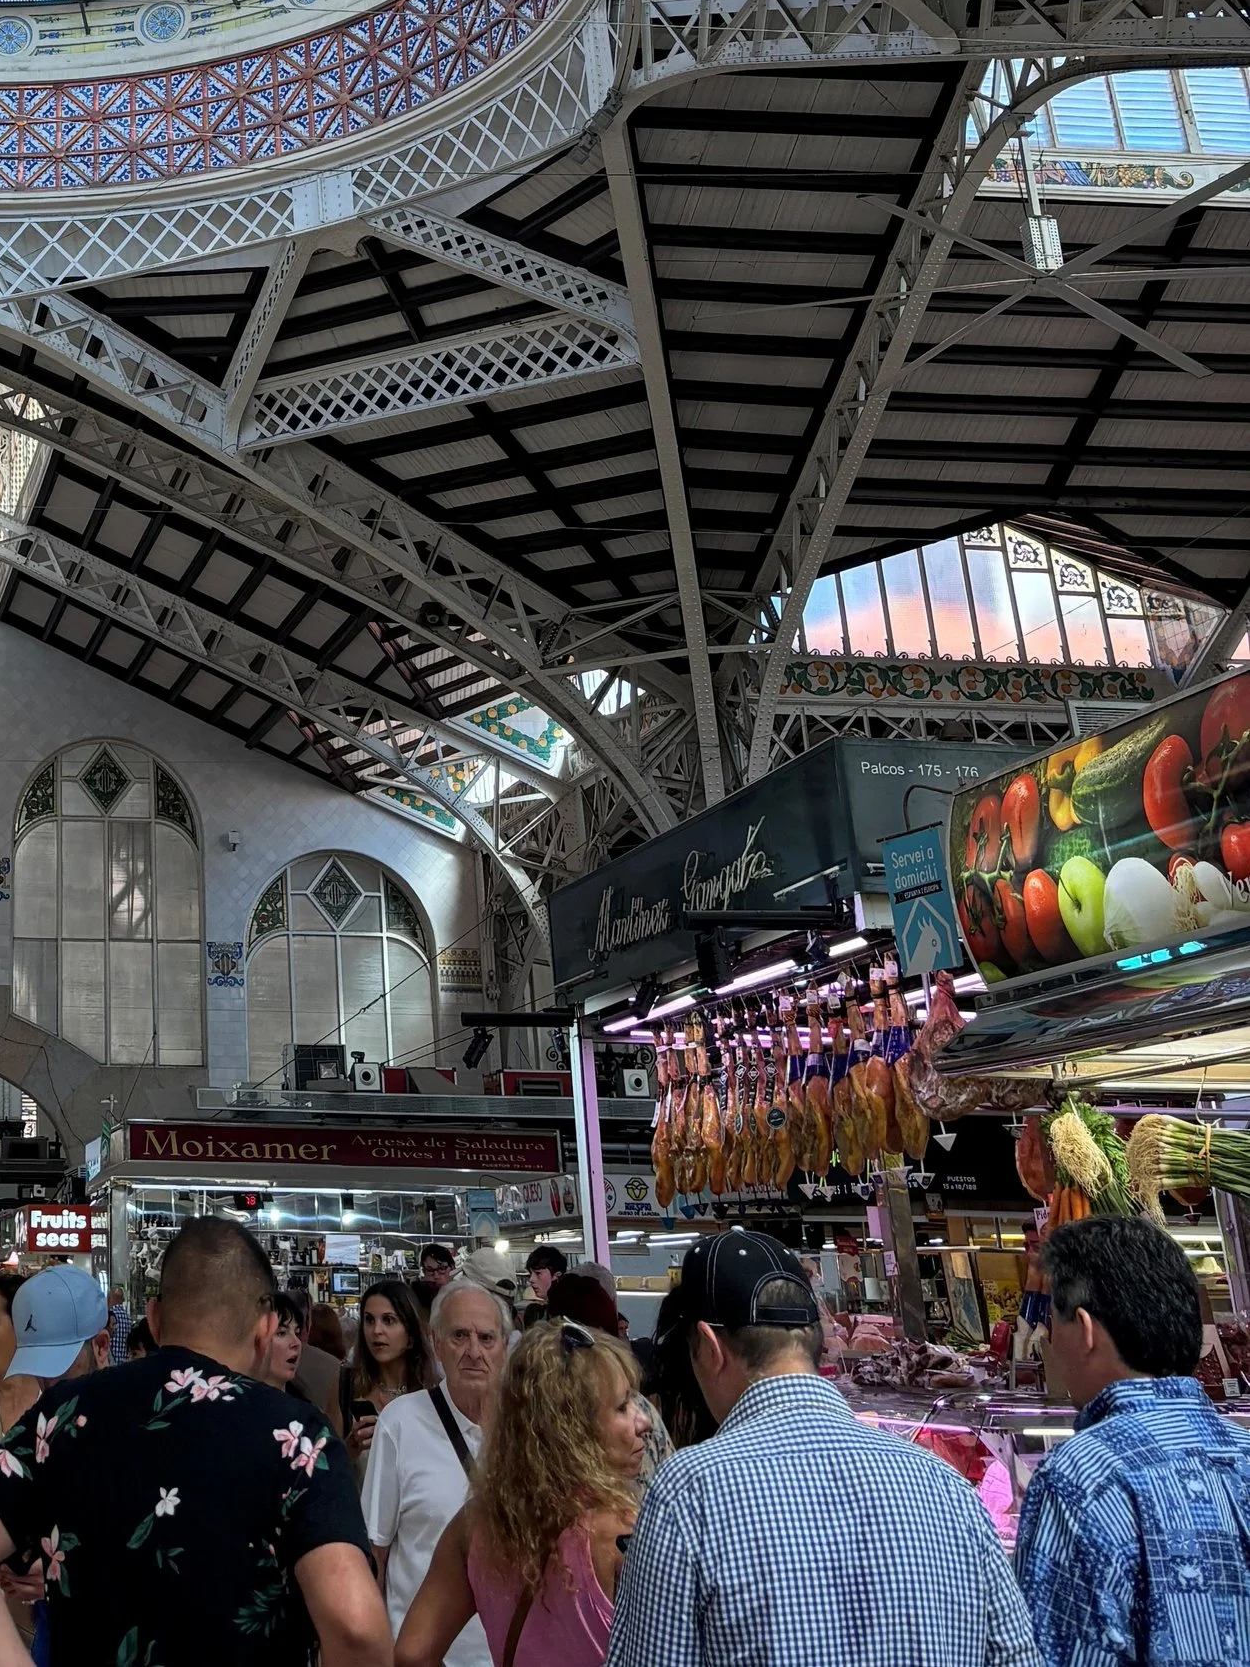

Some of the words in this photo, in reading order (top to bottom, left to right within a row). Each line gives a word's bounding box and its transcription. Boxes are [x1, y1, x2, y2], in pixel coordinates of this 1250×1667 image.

[860, 761, 905, 776] Palcos
[918, 764, 942, 777] 175
[891, 845, 925, 869] Servei
[928, 847, 934, 860] a
[894, 863, 938, 890] domicili
[143, 1129, 338, 1161] Moixamer
[351, 1134, 416, 1148] Artesà
[424, 1135, 447, 1149] de
[454, 1137, 546, 1152] Saladura
[371, 1147, 434, 1160] Olives
[441, 1148, 446, 1160] i
[454, 1149, 527, 1162] Fumats
[947, 1175, 976, 1183] PUESTOS
[522, 1183, 542, 1203] QUESO
[30, 1209, 87, 1229] Fruits
[36, 1232, 80, 1248] secs
